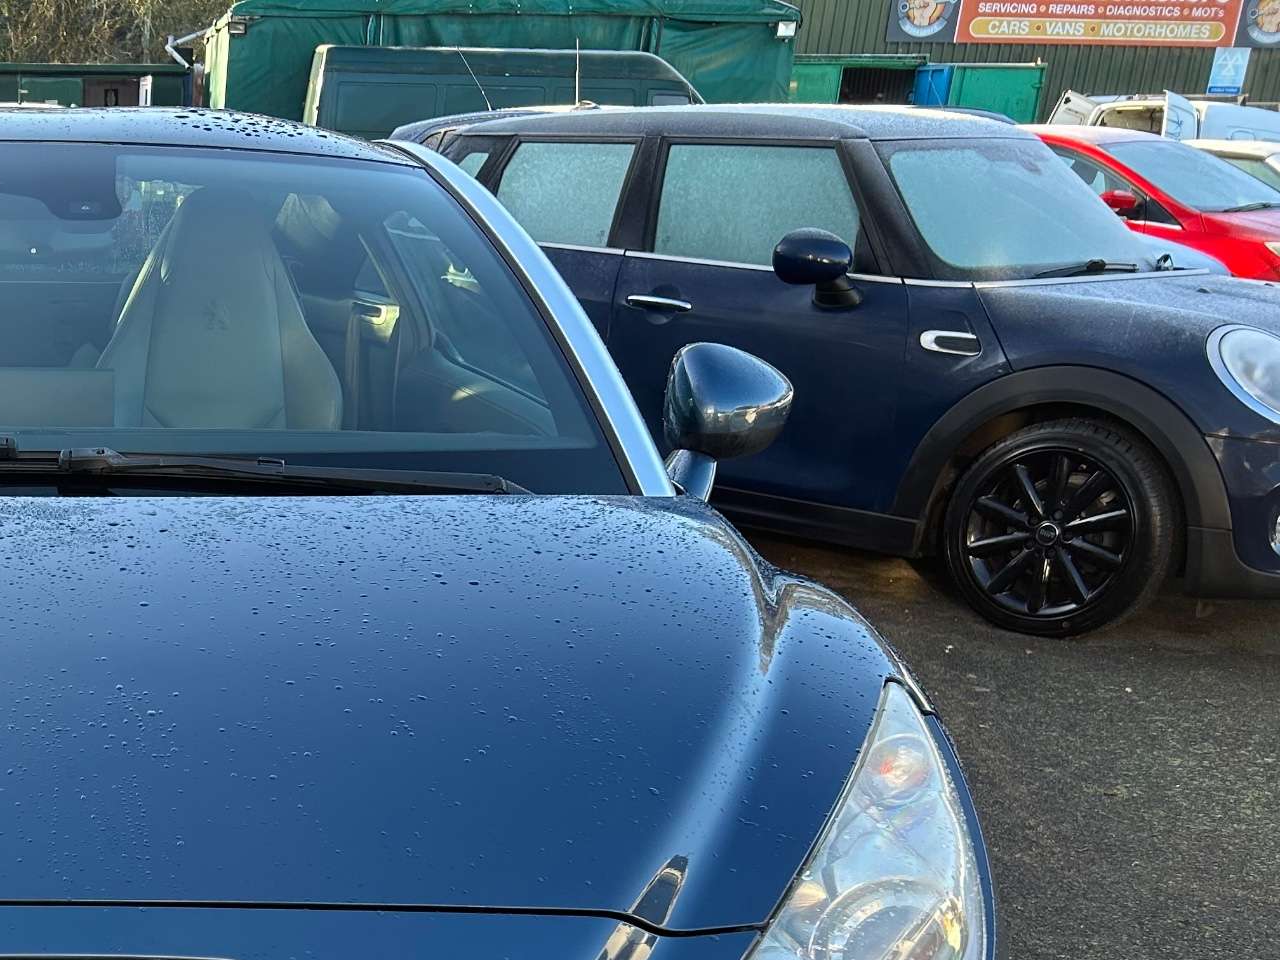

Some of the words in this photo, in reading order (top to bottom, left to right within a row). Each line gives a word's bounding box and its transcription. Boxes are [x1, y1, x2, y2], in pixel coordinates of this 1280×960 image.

[978, 3, 1037, 14] SERVICING
[1048, 4, 1095, 15] REPAIRS
[1106, 5, 1181, 17] DIAGNOSTICS
[1191, 7, 1225, 17] MOT's
[988, 21, 1030, 34] CARS
[1045, 22, 1085, 36] VANS
[1100, 23, 1210, 38] MOTORHOMES
